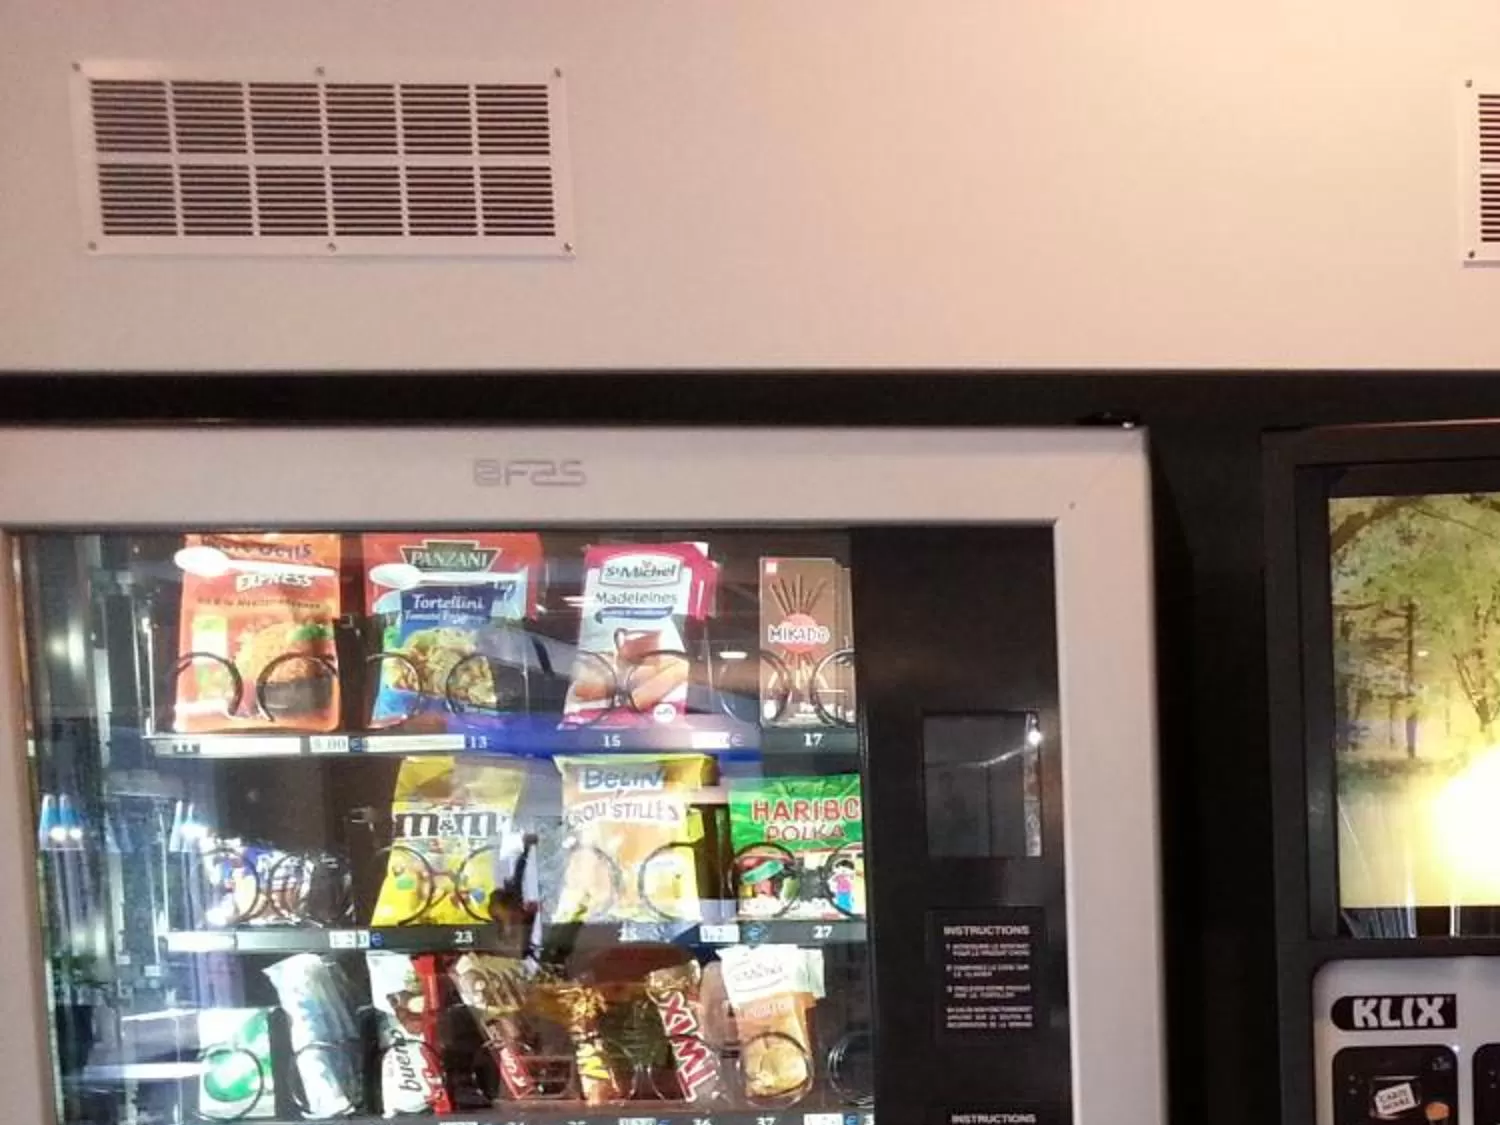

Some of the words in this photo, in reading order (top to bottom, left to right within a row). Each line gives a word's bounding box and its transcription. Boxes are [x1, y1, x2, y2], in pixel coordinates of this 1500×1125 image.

[410, 551, 488, 567] PANZANI
[595, 591, 678, 605] Madeleines
[603, 735, 621, 747] 15
[803, 733, 824, 746] 17
[752, 797, 861, 822] HARIBO
[765, 824, 845, 841] POLKA
[454, 931, 474, 944] 23
[943, 925, 1030, 937] INSTRUCTIONS
[1352, 996, 1446, 1029] KLIX
[658, 991, 716, 1103] TWIX
[390, 1029, 422, 1092] bueno
[951, 1113, 1037, 1125] INSTRUCTIONS
